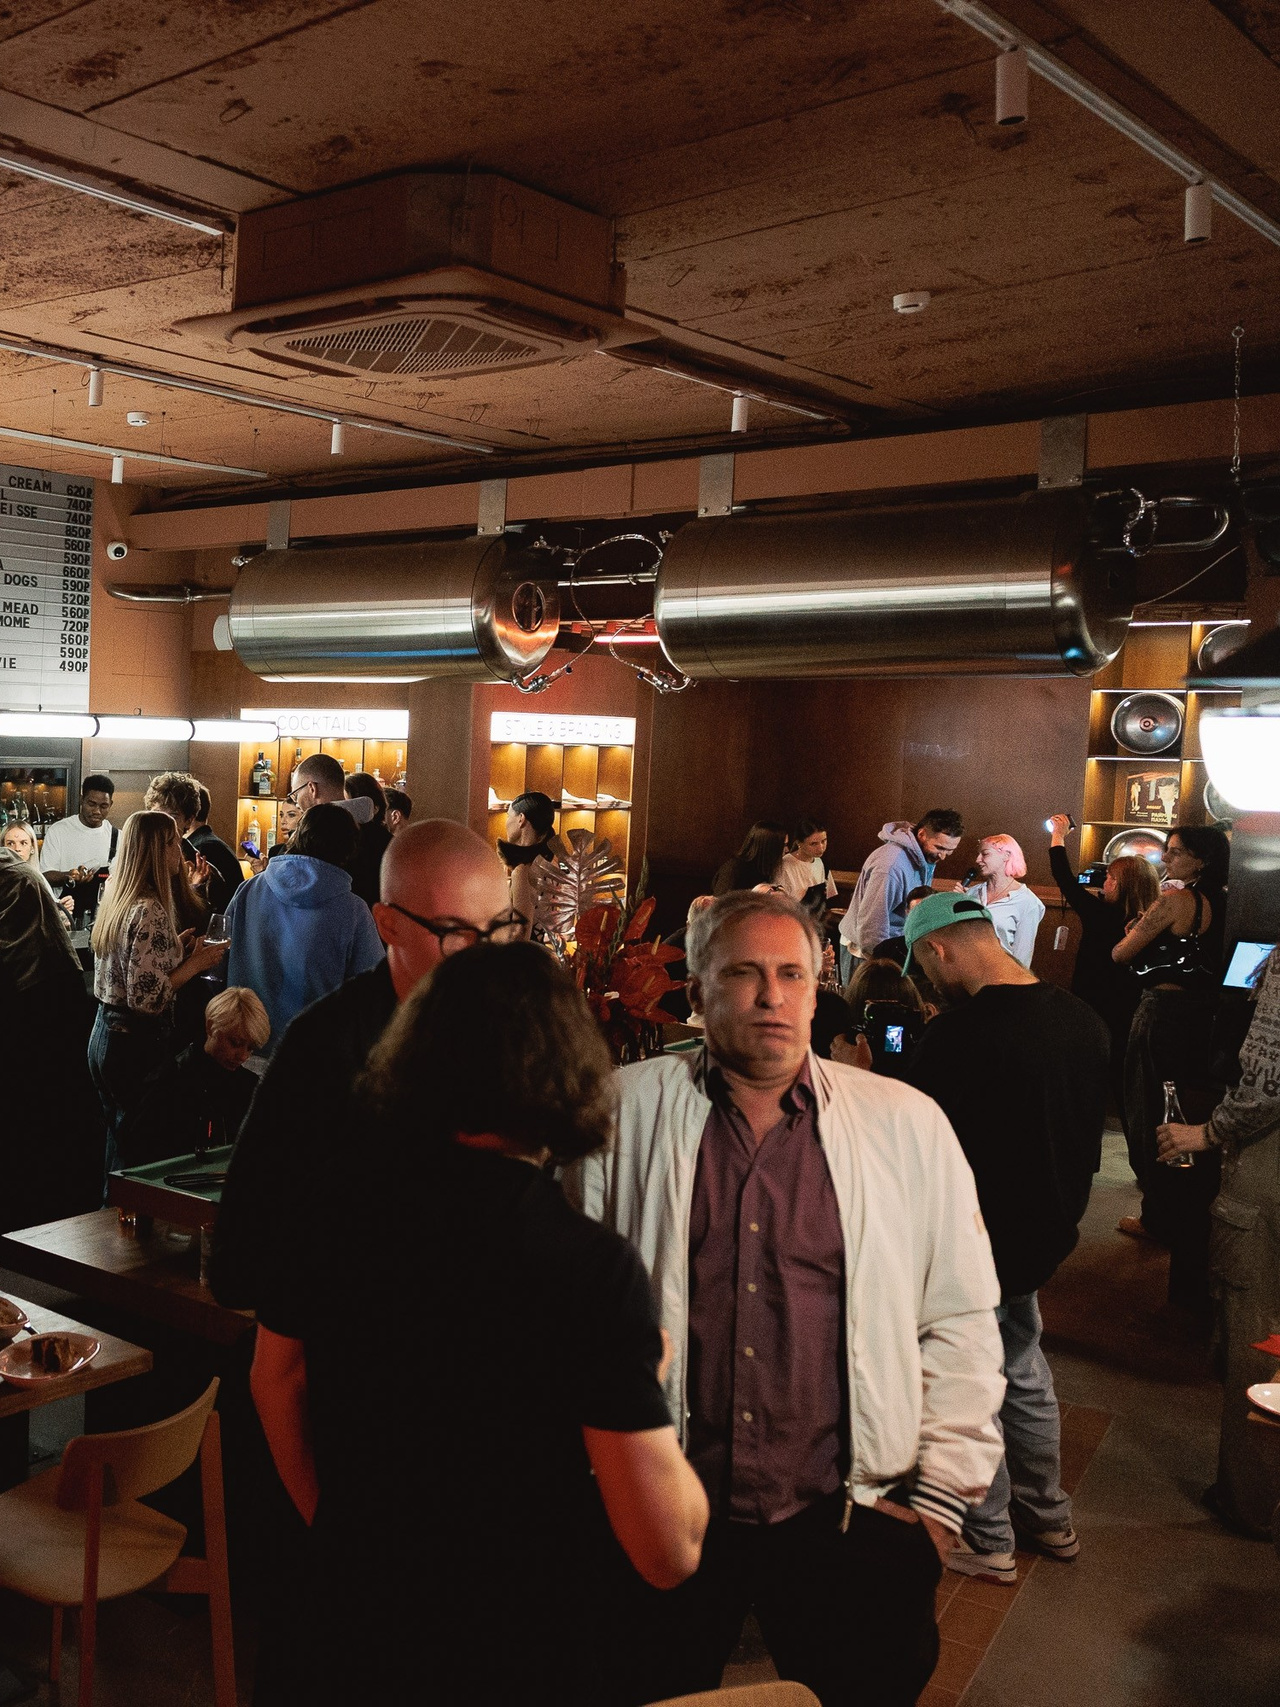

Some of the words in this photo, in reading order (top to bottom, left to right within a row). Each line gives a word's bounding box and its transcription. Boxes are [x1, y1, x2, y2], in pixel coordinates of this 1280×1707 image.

[8, 475, 52, 494] CREAM
[4, 573, 38, 588] DOGS
[2, 601, 39, 616] MEAD
[277, 715, 367, 732] COCKTAILS
[560, 721, 622, 739] BRANDNG
